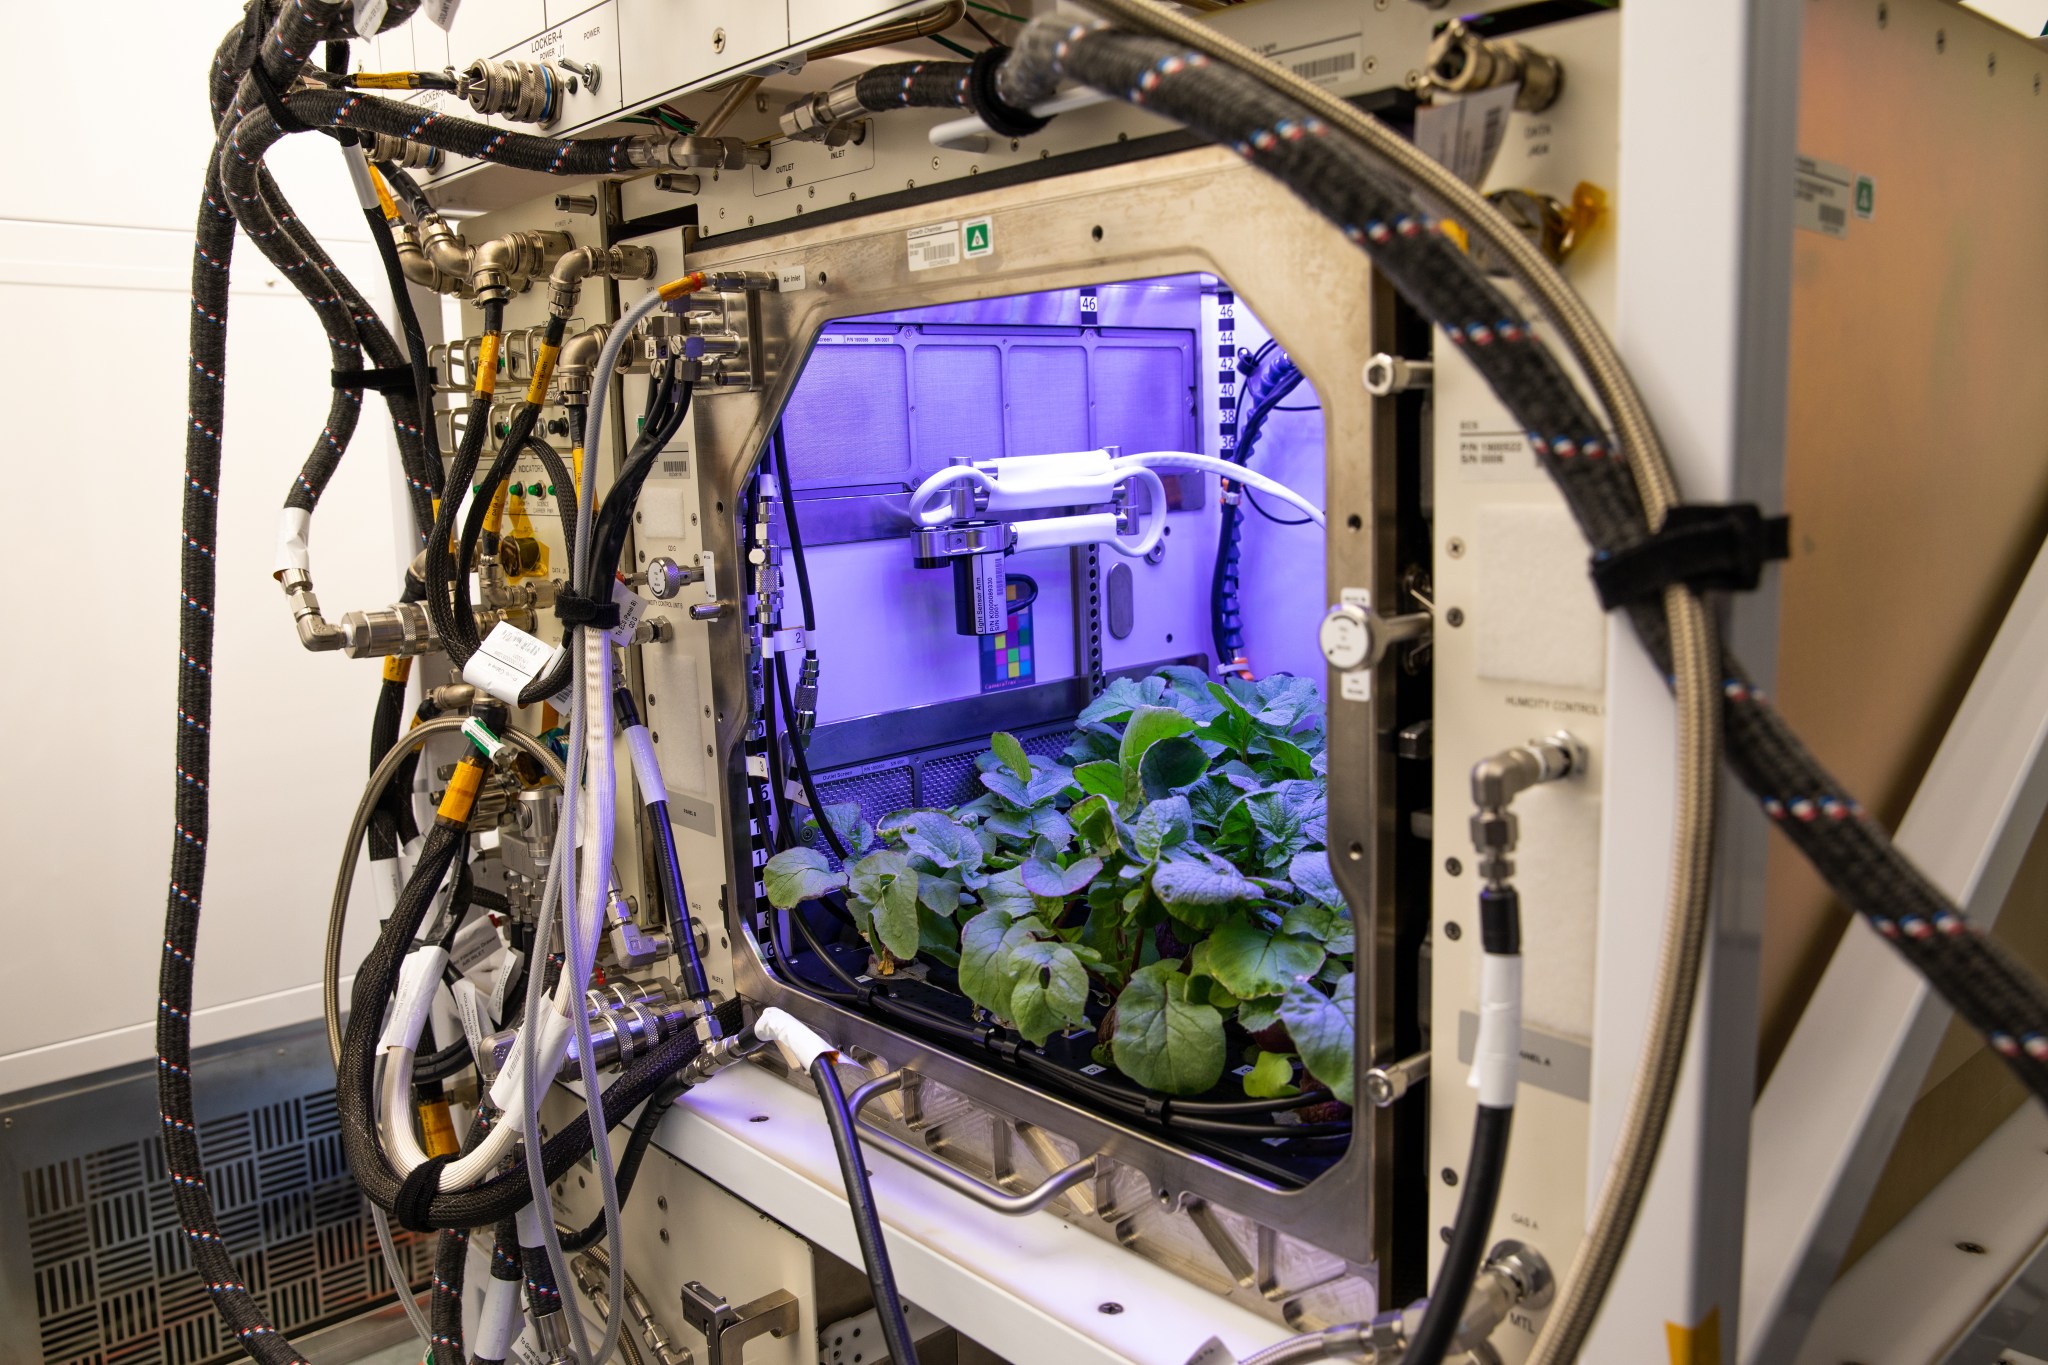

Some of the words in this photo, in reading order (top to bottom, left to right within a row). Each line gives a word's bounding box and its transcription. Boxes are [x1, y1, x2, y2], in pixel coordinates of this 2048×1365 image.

[584, 27, 600, 40] POWER
[531, 29, 563, 53] LOCKER-4
[540, 48, 555, 60] POWER
[830, 150, 845, 159] INLET
[776, 163, 794, 173] OUTLET
[909, 229, 923, 237] Growth
[924, 226, 943, 234] Chamber
[783, 275, 791, 283] Air
[791, 274, 801, 282] Inlet
[1083, 298, 1095, 310] 46
[1220, 305, 1233, 317] 46
[1221, 331, 1233, 344] 44
[1221, 358, 1233, 370] 42
[1221, 384, 1234, 397] 40
[1222, 410, 1234, 423] 38
[1222, 437, 1234, 449] 36
[518, 465, 543, 473] INDICATORS
[796, 633, 801, 643] 2
[823, 772, 836, 781] Outlet
[837, 770, 852, 779] Screen
[798, 789, 803, 798] 4
[683, 808, 693, 816] PANEL
[460, 945, 480, 960] Filtration
[481, 936, 497, 949] Drawer
[1510, 1312, 1535, 1334] MTL
[525, 1342, 536, 1357] Growth
